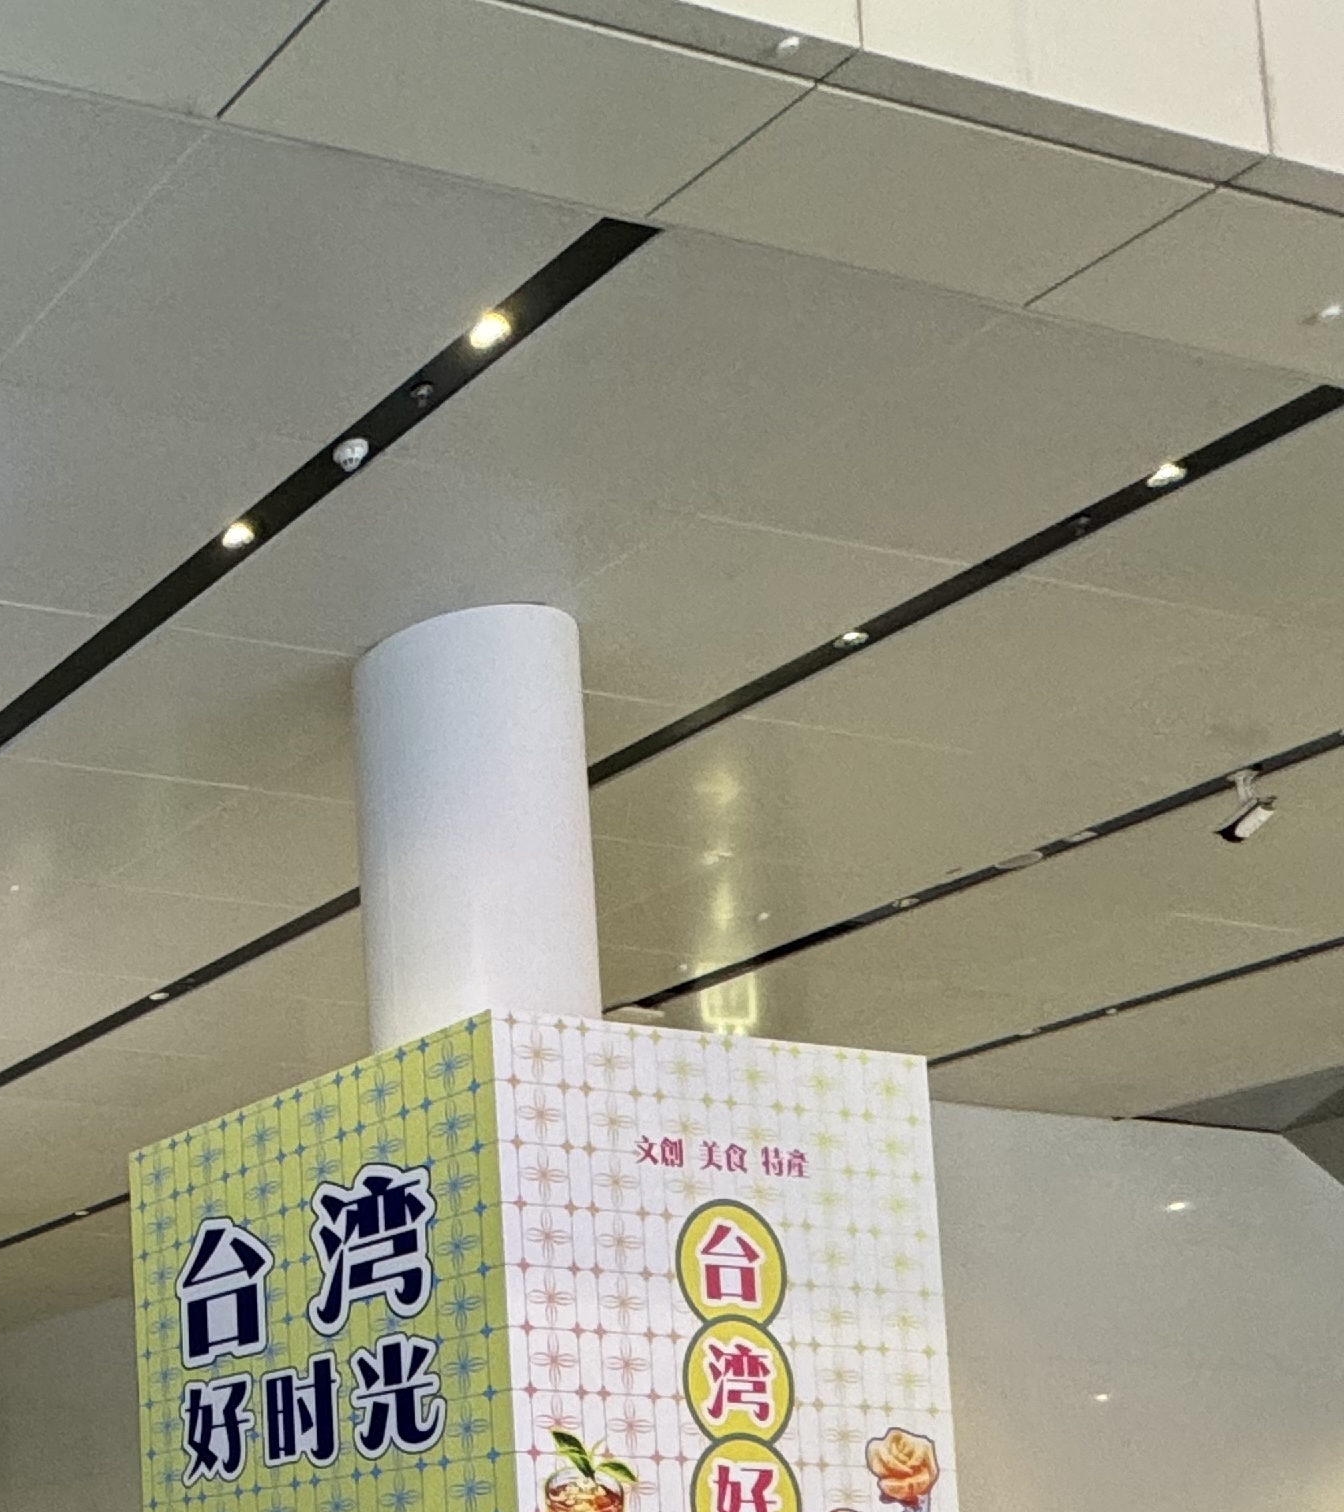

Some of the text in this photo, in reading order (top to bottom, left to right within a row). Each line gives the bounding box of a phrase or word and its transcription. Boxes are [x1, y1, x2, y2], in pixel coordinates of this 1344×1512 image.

[634, 1135, 684, 1168] 文創
[699, 1140, 748, 1174] 美食
[182, 1176, 428, 1358] 台湾
[184, 1343, 443, 1480] 好时光
